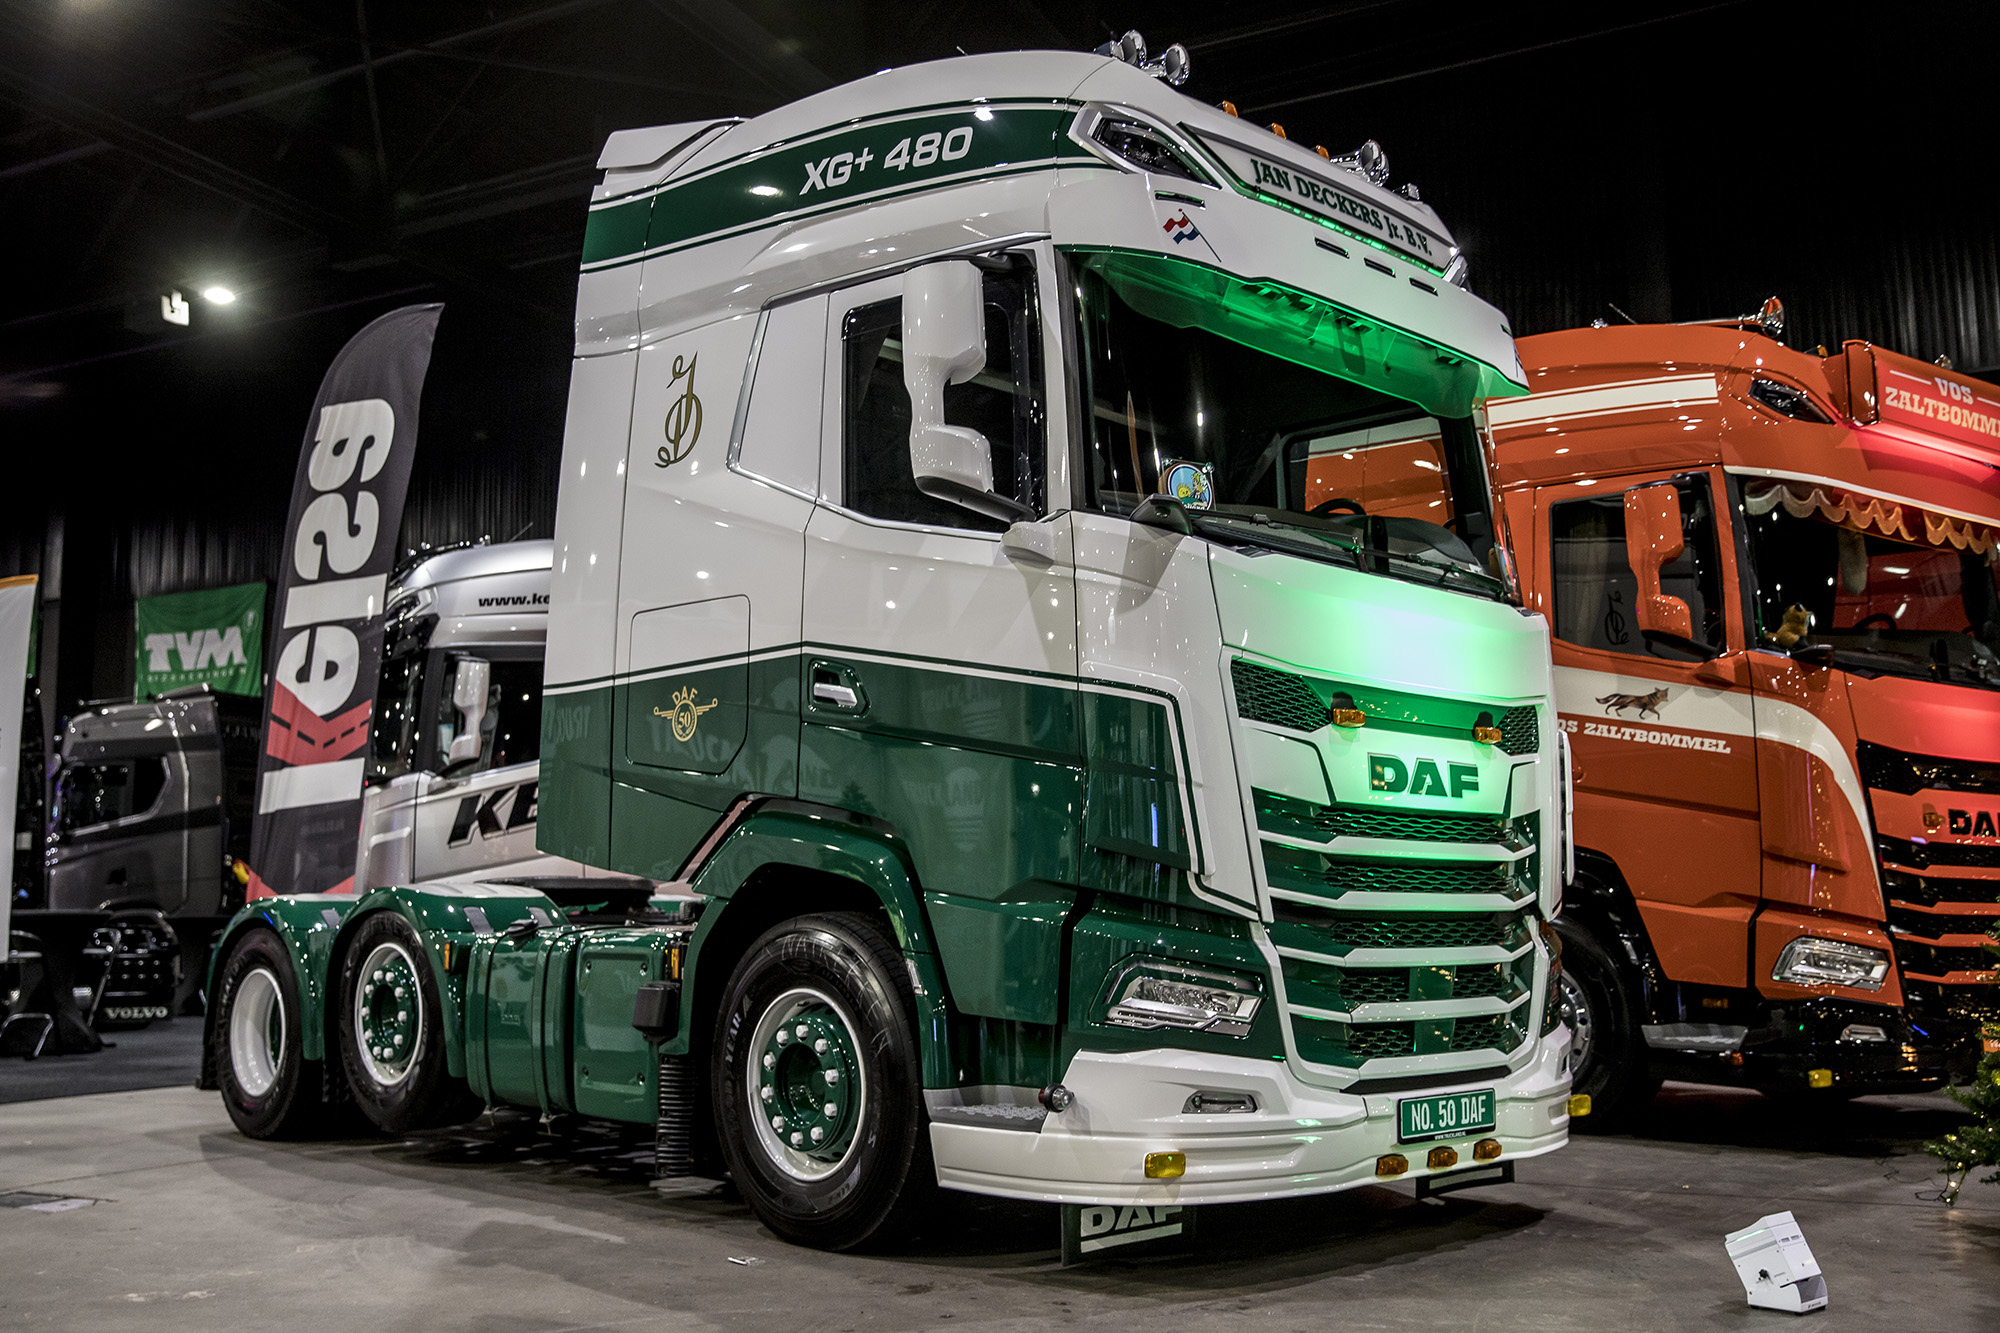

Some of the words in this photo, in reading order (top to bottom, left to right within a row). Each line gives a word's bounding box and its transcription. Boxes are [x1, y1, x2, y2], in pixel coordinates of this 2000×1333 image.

[799, 147, 874, 196] XG+
[883, 126, 973, 171] 480
[1250, 158, 1292, 192] JAN
[1293, 174, 1383, 231] DECKERS
[1383, 214, 1404, 241] Jr.
[1402, 224, 1433, 257] B.V.
[1934, 376, 1974, 405] VOS
[144, 626, 248, 673] TVM
[672, 685, 698, 705] DAF
[678, 711, 691, 728] 50
[1557, 718, 1579, 734] OS
[1583, 722, 1731, 754] ZALTBOMMEL
[1367, 752, 1480, 799] DAF
[1948, 808, 2000, 838] DA
[104, 1006, 168, 1019] VOLVO
[724, 1013, 743, 1067] YEAR
[1411, 1102, 1434, 1132] NO.
[1438, 1099, 1456, 1128] 50
[1461, 1095, 1487, 1125] DAF
[1080, 1204, 1183, 1238] DAF
